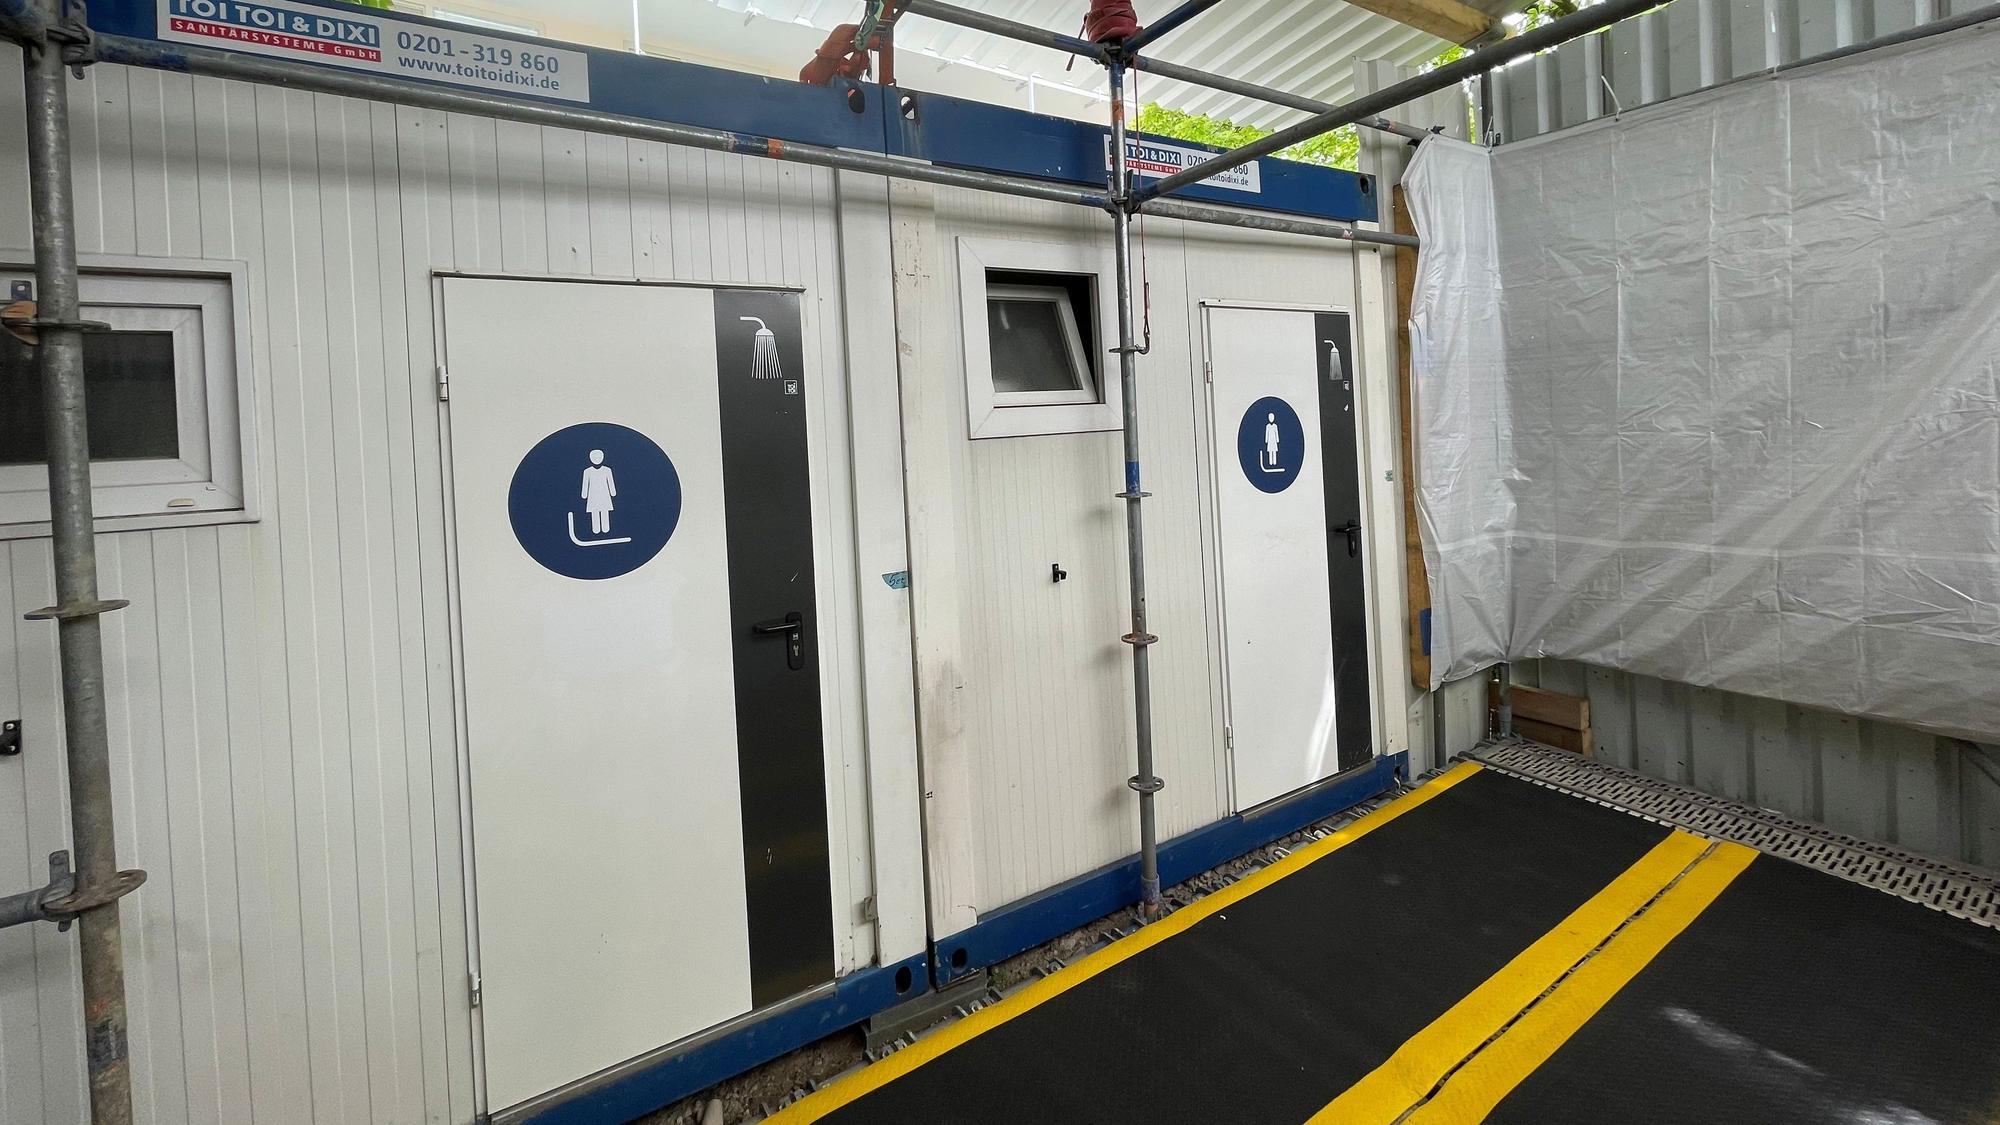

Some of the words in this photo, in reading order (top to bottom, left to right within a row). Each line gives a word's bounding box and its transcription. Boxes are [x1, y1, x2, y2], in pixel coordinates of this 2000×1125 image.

[180, 0, 227, 19] TOI
[235, 5, 285, 29] TOI
[292, 16, 310, 33] &
[317, 18, 375, 44] DIXI
[175, 20, 325, 51] SANITÄRSYSTEME
[334, 46, 378, 60] GmbH
[398, 56, 560, 90] www.toitoidixi.de
[520, 52, 559, 74] 860
[1150, 151, 1158, 160] &
[1159, 151, 1181, 164] DIXI
